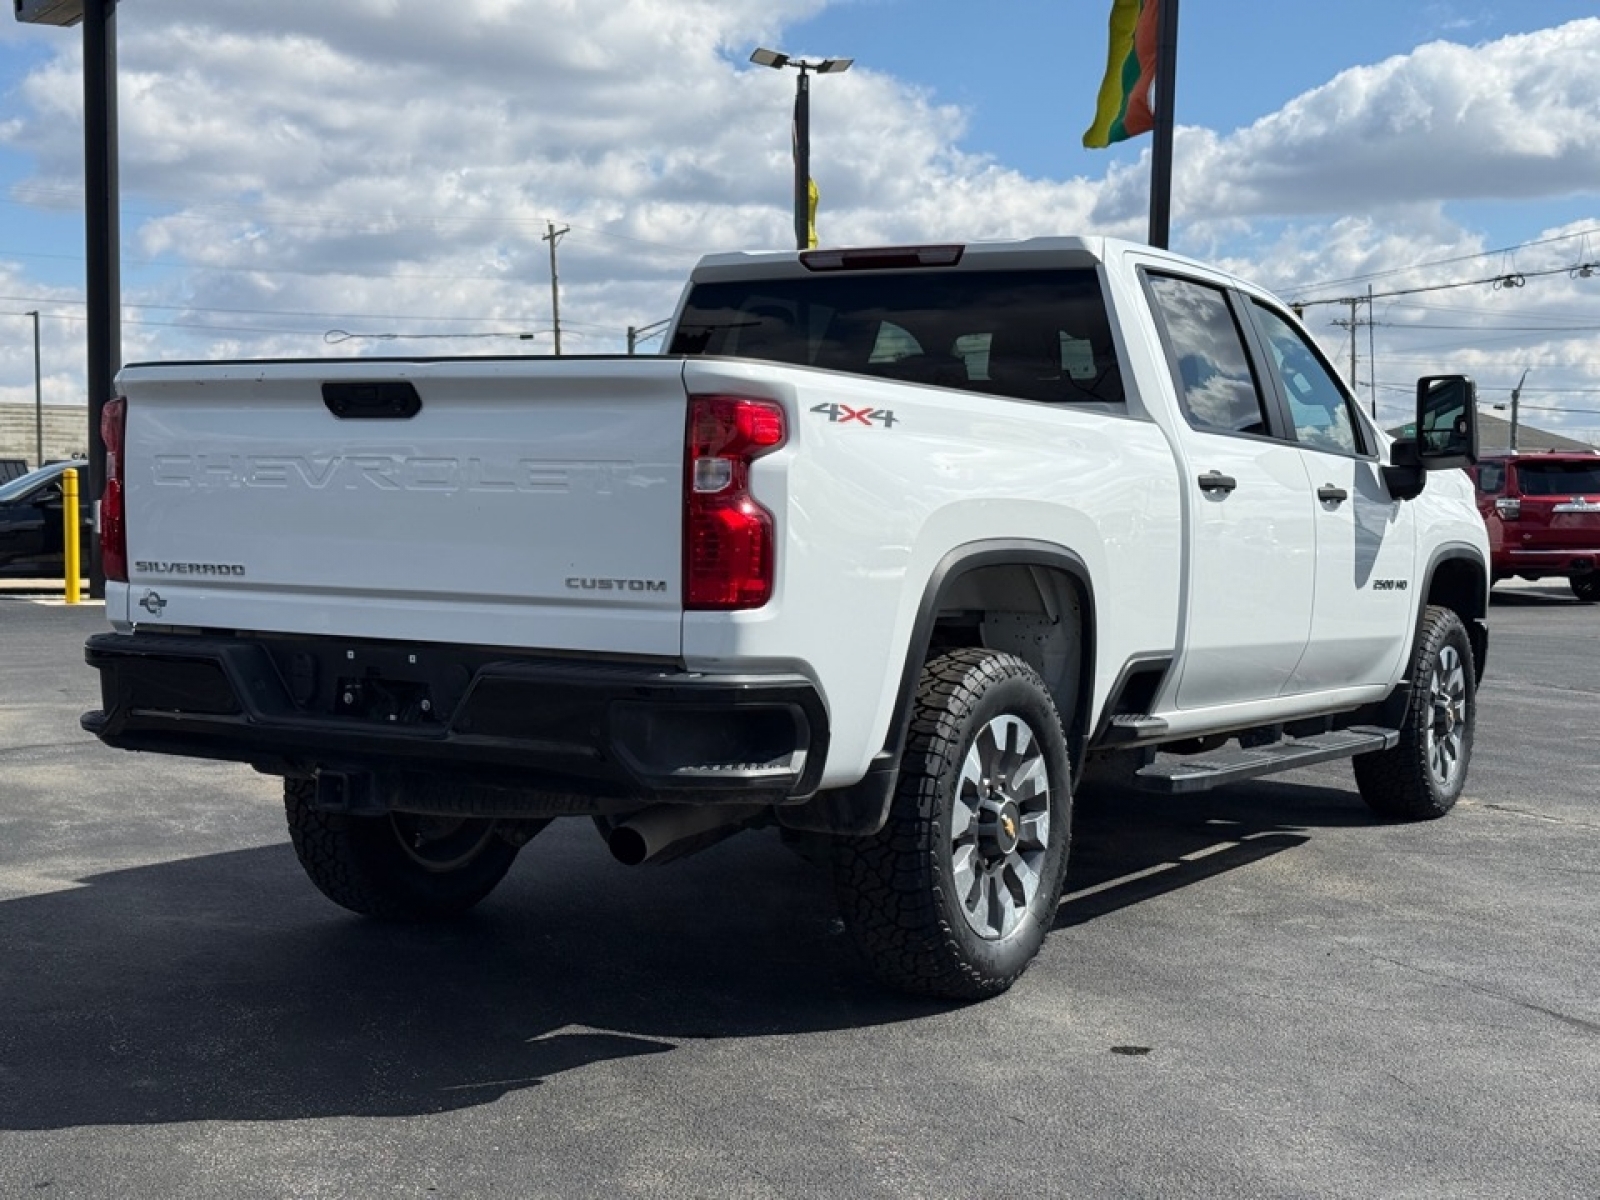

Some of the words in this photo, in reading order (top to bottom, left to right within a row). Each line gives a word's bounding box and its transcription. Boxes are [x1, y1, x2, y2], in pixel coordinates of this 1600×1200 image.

[151, 454, 634, 495] CHEVROLET
[135, 561, 245, 576] SILVERADO
[565, 578, 667, 591] CUSTOM
[1372, 579, 1393, 591] 2500
[1394, 579, 1408, 591] HD
